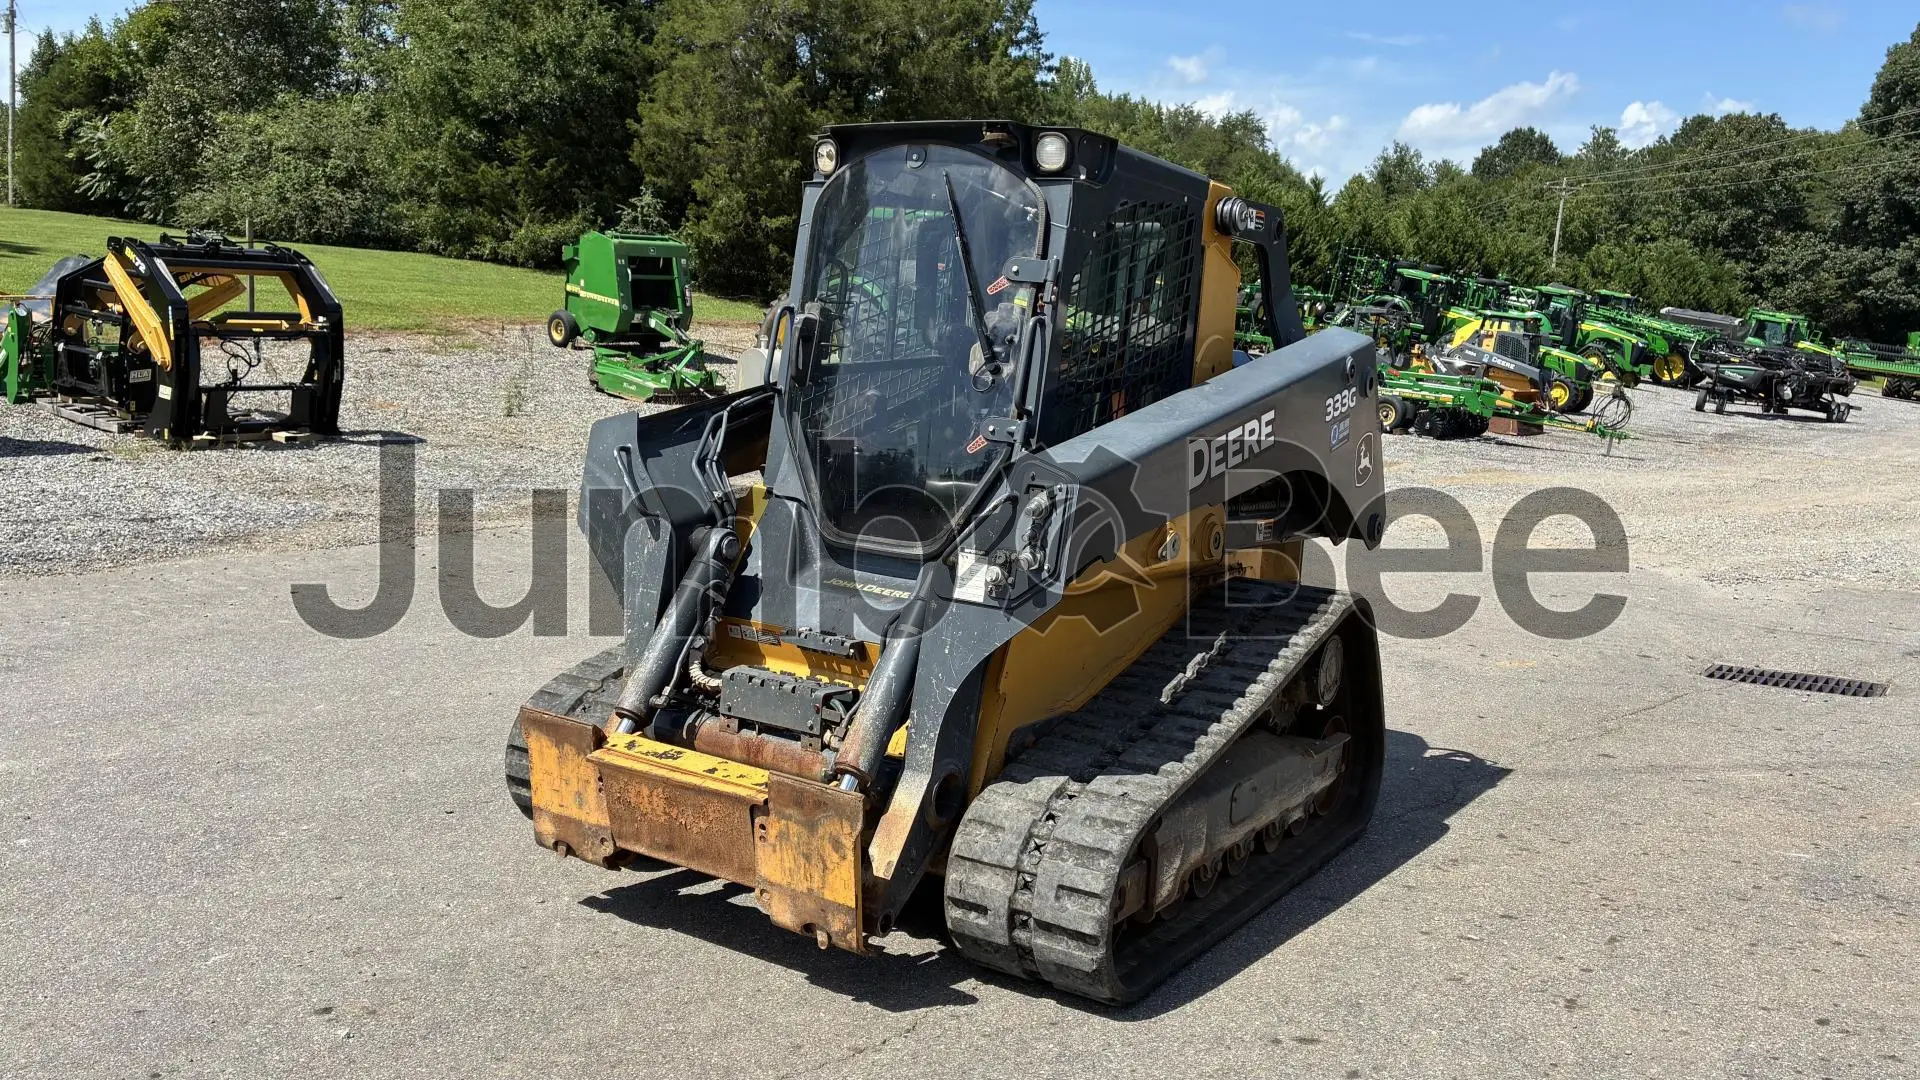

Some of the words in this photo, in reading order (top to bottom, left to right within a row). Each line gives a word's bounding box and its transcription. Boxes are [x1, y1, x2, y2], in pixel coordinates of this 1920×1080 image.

[124, 246, 146, 274] BK72
[1491, 355, 1516, 370] DEERE
[1325, 387, 1357, 422] 333G
[1189, 409, 1275, 490] DEERE
[823, 578, 861, 590] JOHN
[862, 584, 911, 599] DEERE
